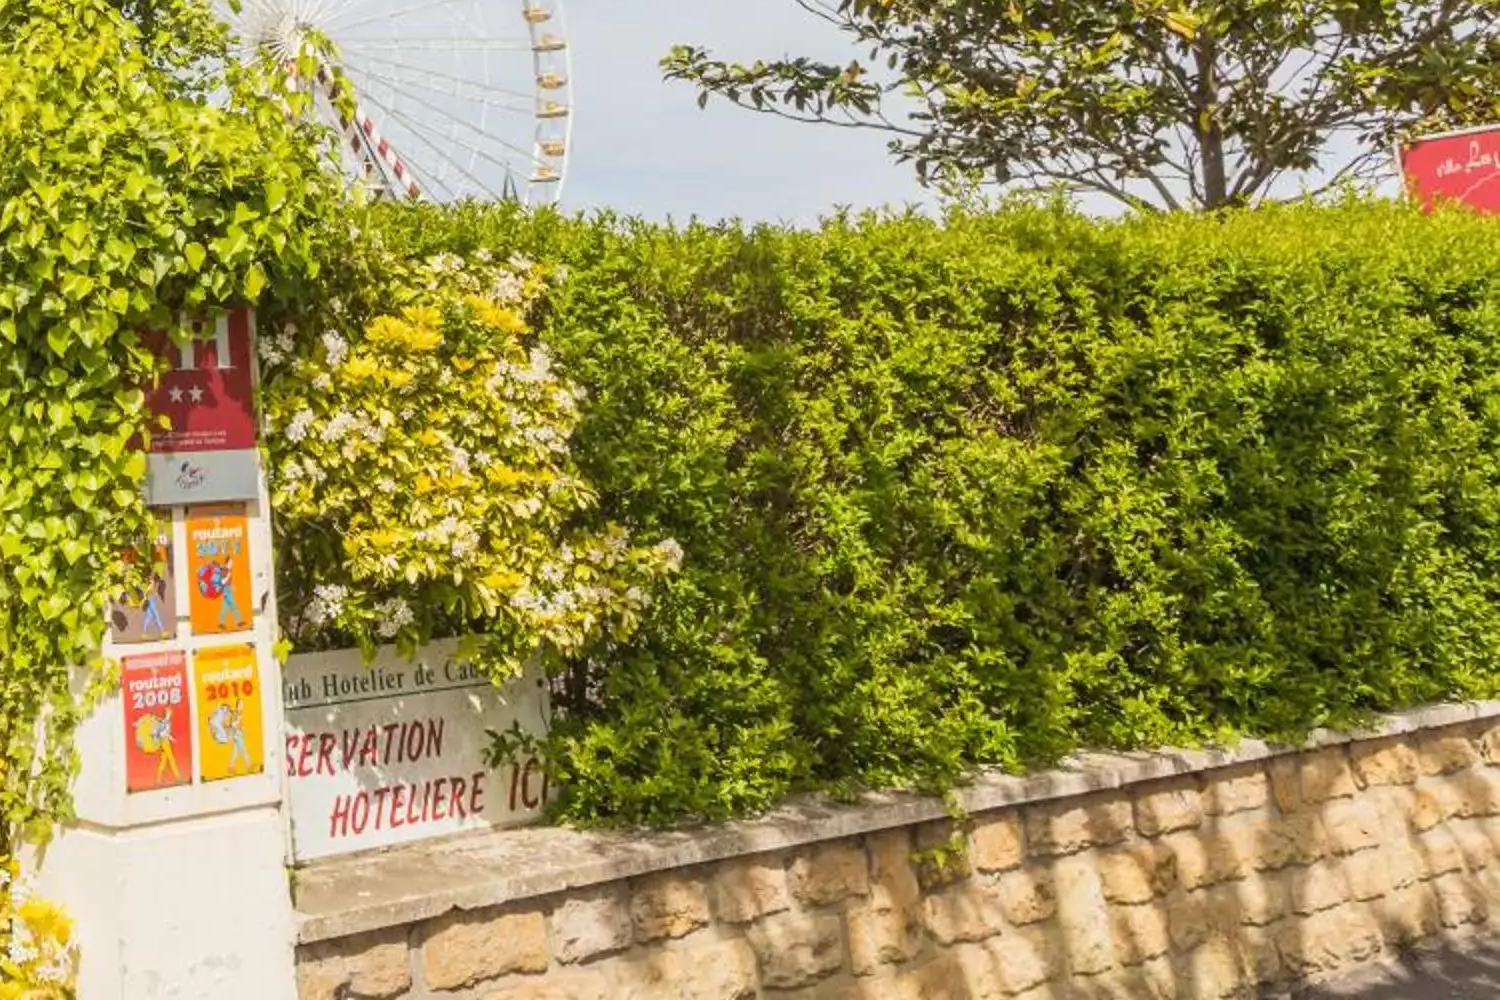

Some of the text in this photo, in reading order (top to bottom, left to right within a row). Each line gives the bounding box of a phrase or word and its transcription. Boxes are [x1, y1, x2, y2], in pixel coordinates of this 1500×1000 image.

[193, 526, 243, 540] routard
[129, 673, 182, 692] routard
[202, 663, 253, 684] routard
[322, 667, 405, 698] Hotelier
[414, 662, 435, 687] de
[205, 680, 253, 702] 2010
[285, 718, 445, 777] SERVATION
[329, 757, 549, 838] HOTELIERE ICI
